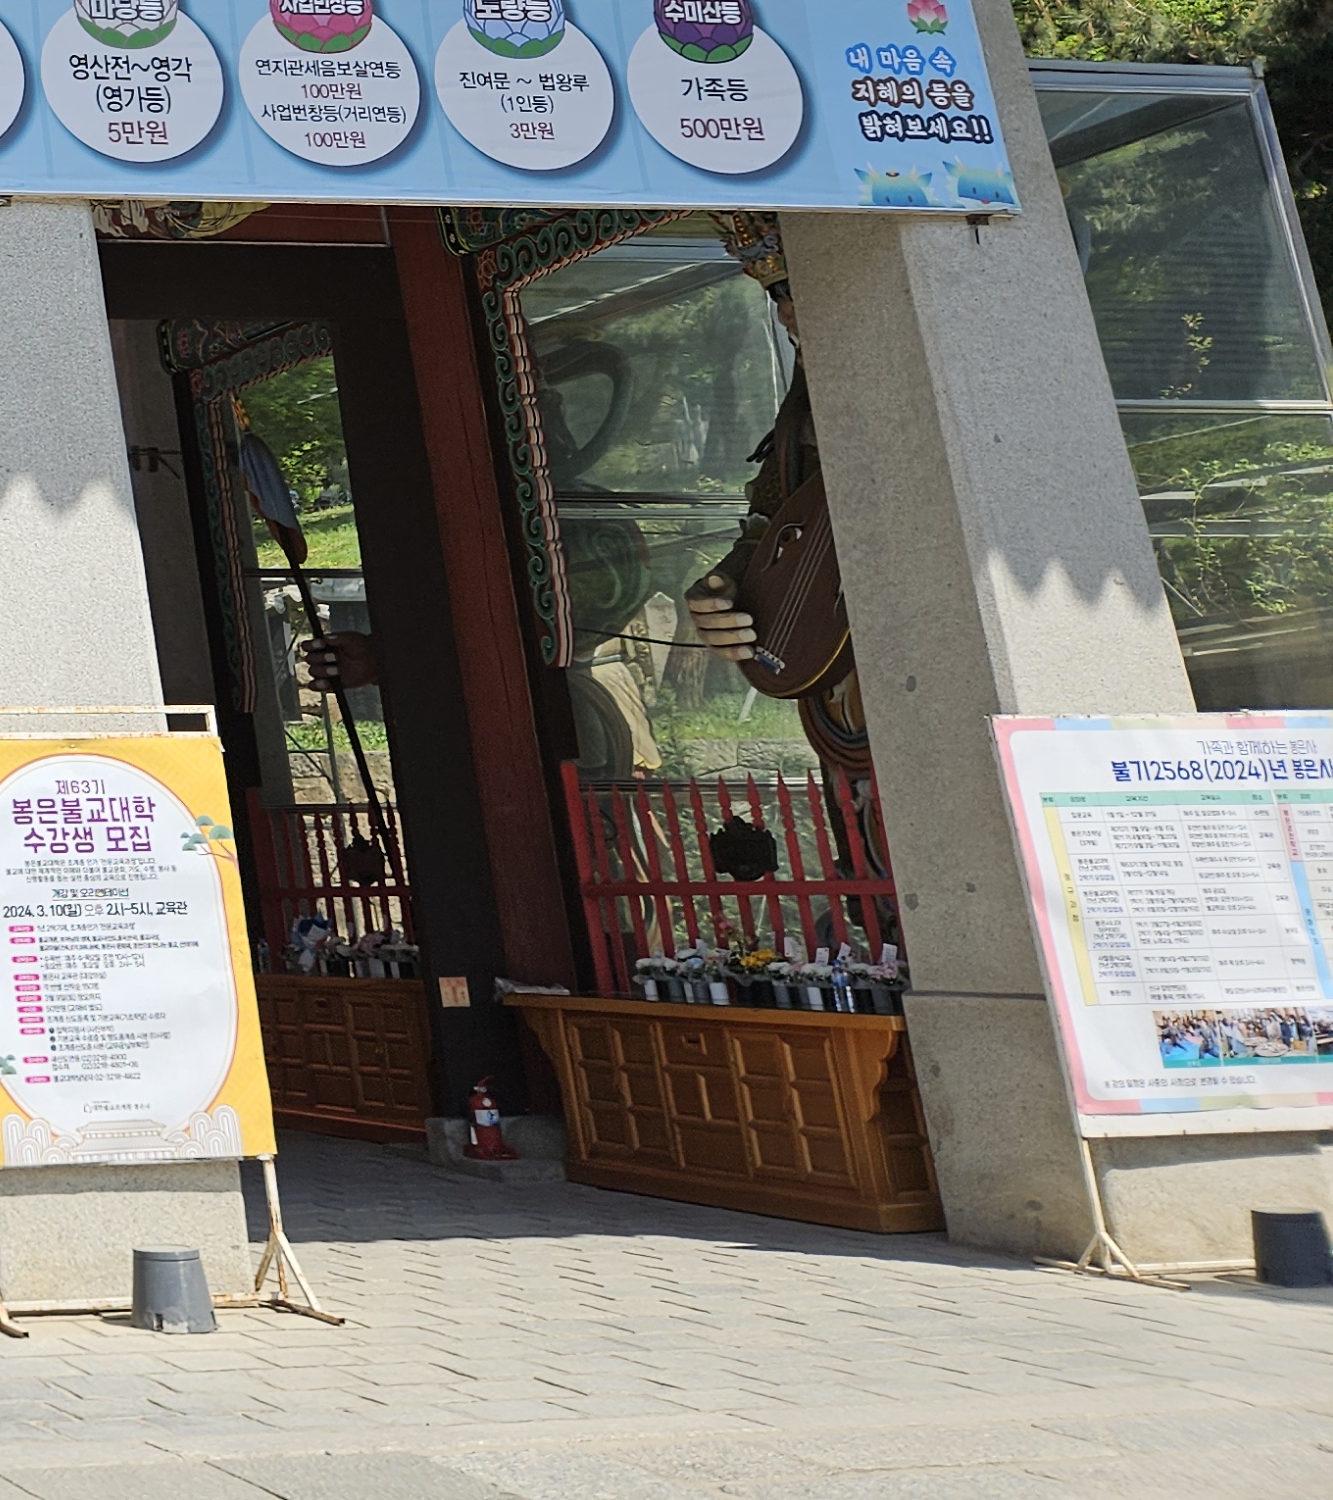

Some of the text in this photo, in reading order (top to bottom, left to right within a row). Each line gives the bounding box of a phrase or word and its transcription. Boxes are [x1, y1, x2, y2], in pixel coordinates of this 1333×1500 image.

[664, 0, 742, 24] 수미산등
[69, 54, 192, 83] 영산전~영각
[256, 59, 401, 79] 연지관세음보살연등
[848, 46, 954, 75] 내 마음 속
[301, 83, 362, 100] 100만원
[459, 72, 510, 90] 진여문
[539, 73, 589, 92] 법왕루
[682, 77, 749, 102] 가족등
[853, 79, 972, 109] 지혜의 등을
[96, 84, 171, 114] (영가등)
[500, 95, 554, 114] (1인등)
[261, 104, 407, 124] 사업번창등(거리연등)
[108, 120, 168, 145] 5만원
[510, 122, 555, 140] 3만원
[680, 117, 765, 141] 500만원
[860, 112, 991, 142] 밝혀보세요!!
[305, 132, 366, 149] 100만원
[1197, 739, 1317, 755] 가족과 함께하는 봉은사
[1111, 759, 1288, 783] 불기2568(2024)년
[55, 780, 106, 795] 제63기
[12, 796, 156, 825] 봉은불교대학
[24, 826, 151, 854] 수강생 모집
[85, 905, 103, 916] 오후
[156, 901, 188, 915] 교육관
